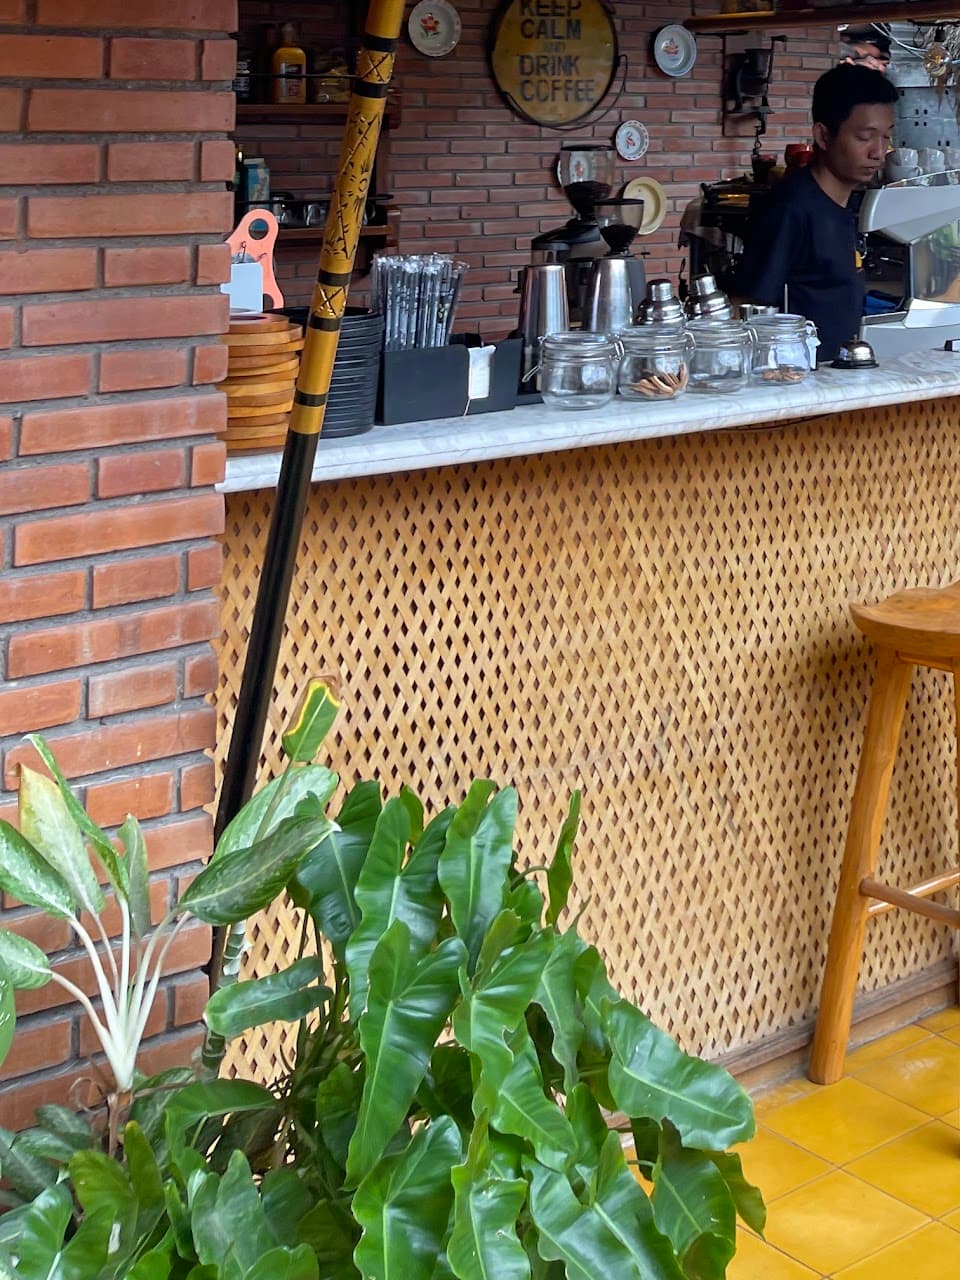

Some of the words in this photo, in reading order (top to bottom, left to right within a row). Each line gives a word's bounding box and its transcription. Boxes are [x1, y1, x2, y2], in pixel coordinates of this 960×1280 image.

[520, 18, 582, 40] CALM
[518, 55, 580, 76] DRINK
[520, 79, 595, 102] COFFEE
